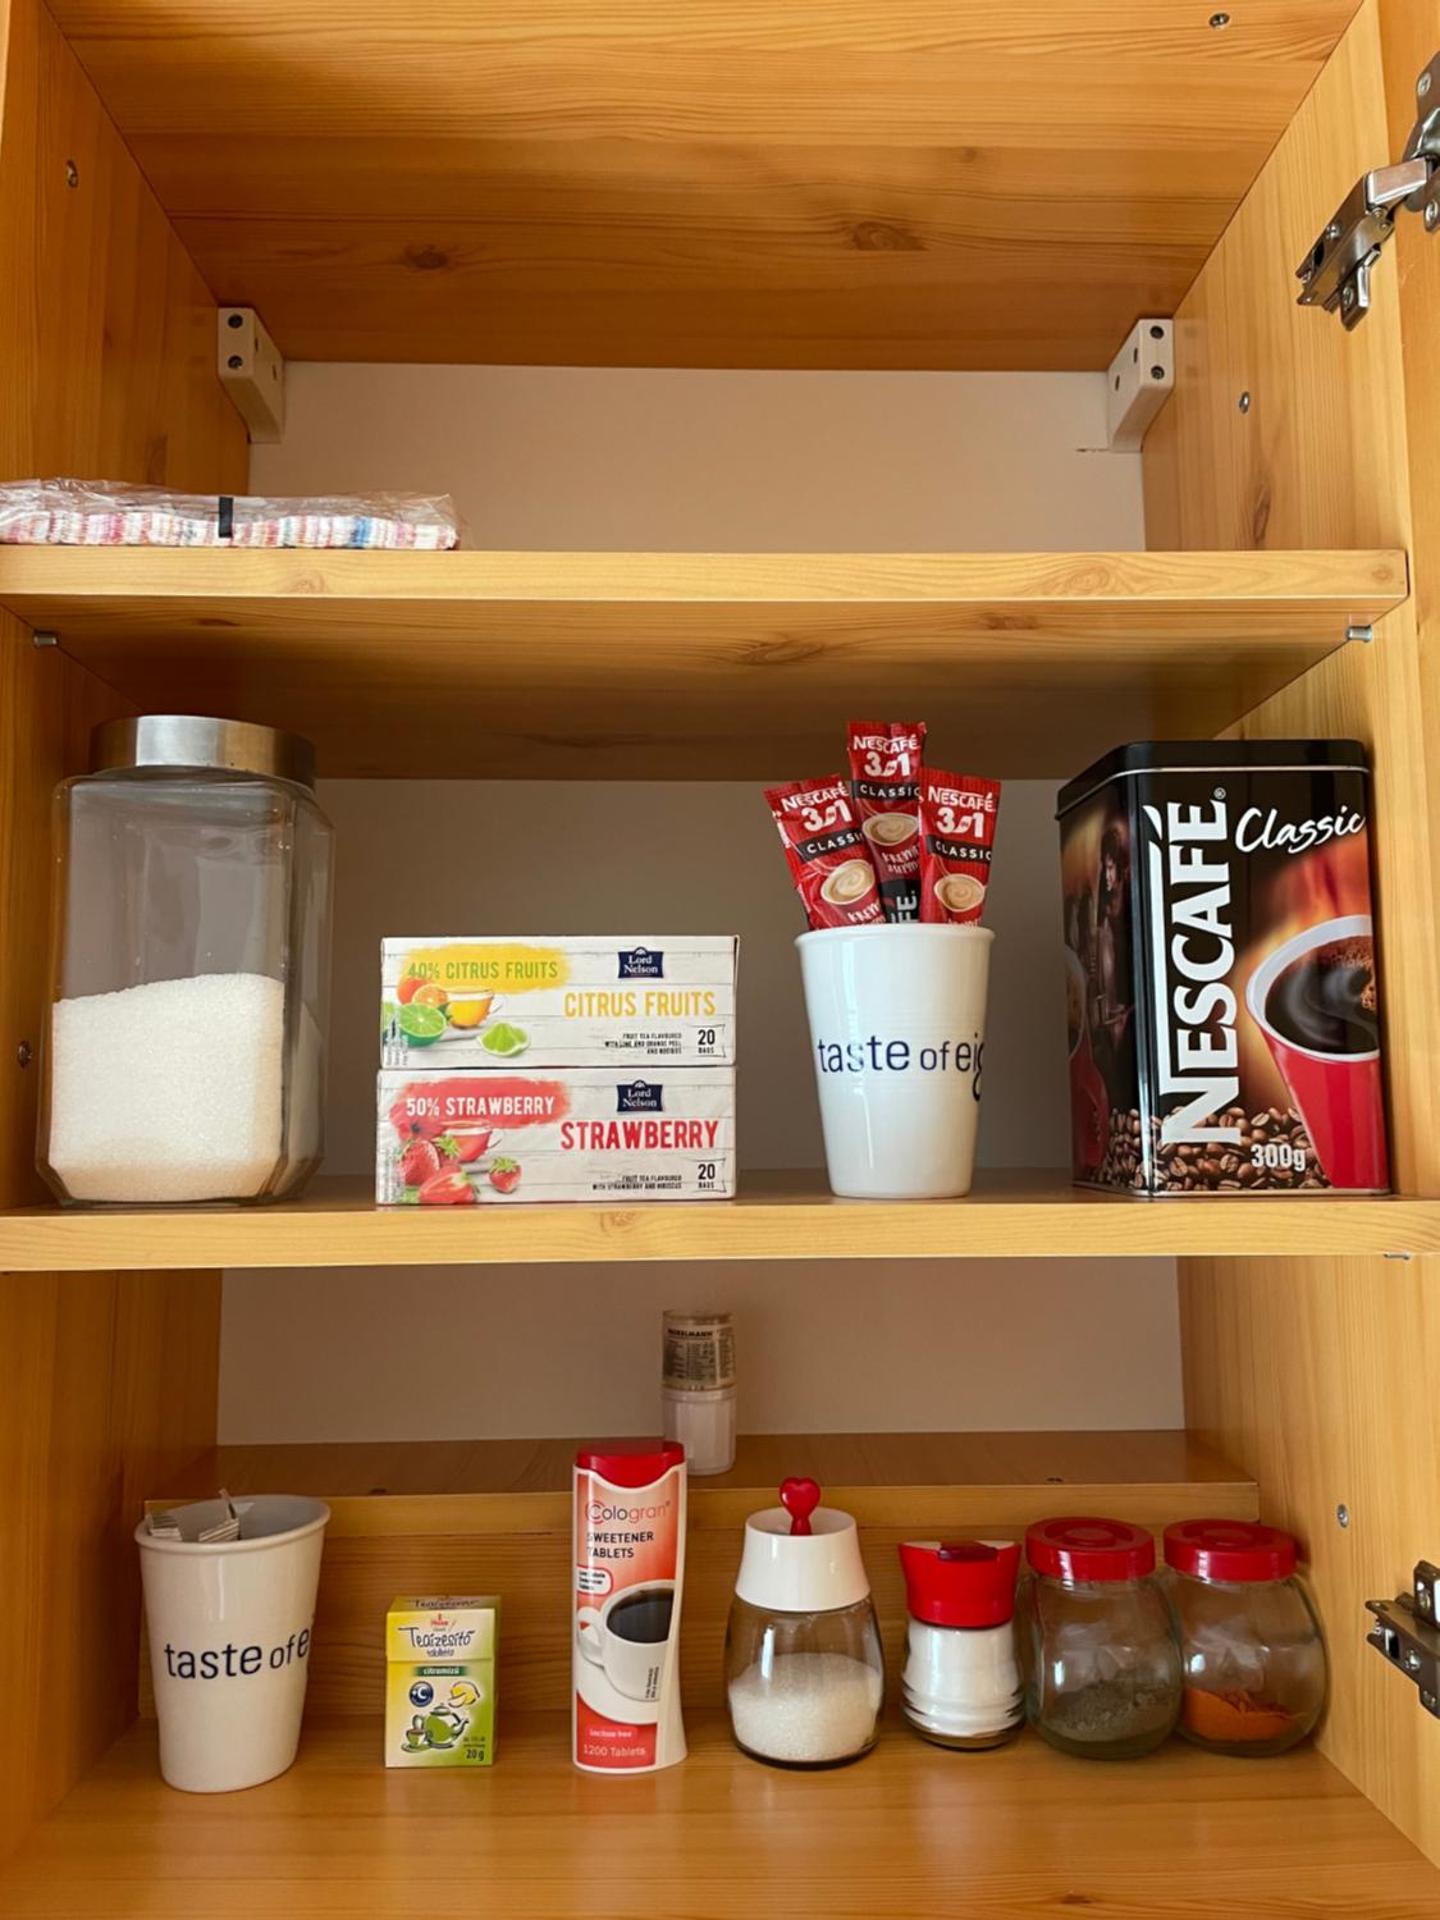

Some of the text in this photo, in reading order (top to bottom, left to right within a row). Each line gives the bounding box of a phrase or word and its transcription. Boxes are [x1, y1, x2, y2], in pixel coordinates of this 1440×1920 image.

[853, 733, 921, 755] NESCAFÉ
[780, 781, 850, 812] NESCAFÉ
[927, 785, 996, 813] NESCAFÉ
[1235, 805, 1366, 854] Classic
[806, 832, 863, 854] CLASSI
[935, 840, 992, 861] CLASSIC
[408, 960, 558, 979] 40% CITRUS FRUITS
[624, 964, 658, 974] Nelson
[628, 955, 652, 965] Lord
[1143, 798, 1242, 1146] NESCAFÉ
[565, 991, 716, 1018] CITRUS FRUITS
[698, 1029, 716, 1046] 20
[818, 1035, 910, 1073] taste
[919, 1041, 951, 1071] of
[623, 1098, 657, 1108] Nelson
[627, 1088, 651, 1098] Lord
[406, 1096, 555, 1118] 50% STRAWBERRY
[560, 1120, 719, 1150] STRAWBERRY
[1251, 1143, 1306, 1172] 300g
[698, 1164, 716, 1180] 20
[585, 1500, 667, 1524] Cologran
[587, 1531, 655, 1544] SWEETENER
[586, 1547, 635, 1559] TABLETS
[164, 1643, 263, 1680] taste
[269, 1633, 297, 1670] of
[584, 1744, 647, 1758] 1200 Tablets
